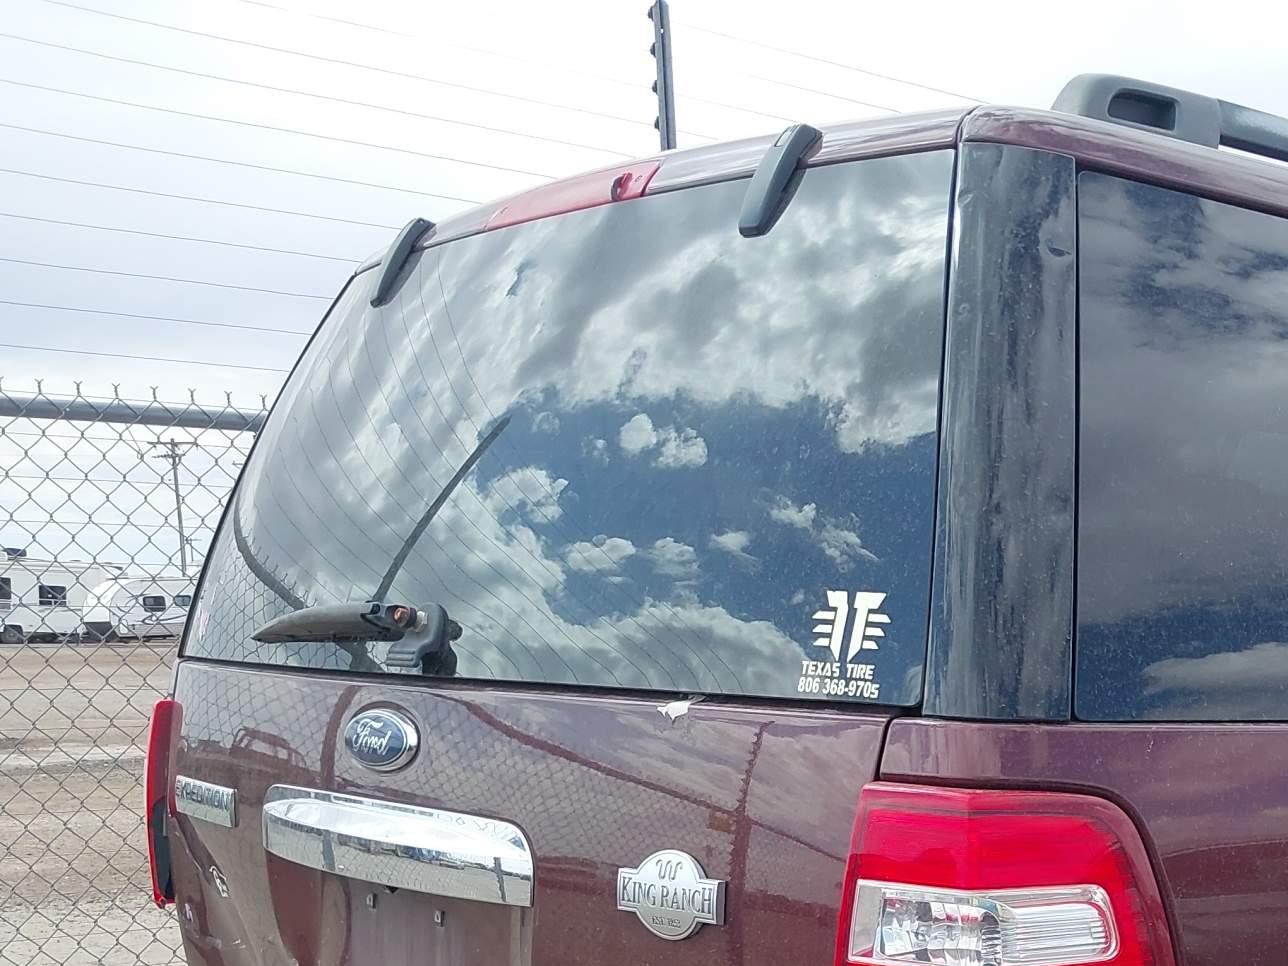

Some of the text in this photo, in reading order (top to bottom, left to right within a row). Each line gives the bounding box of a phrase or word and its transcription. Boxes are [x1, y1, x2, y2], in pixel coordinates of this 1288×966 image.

[802, 661, 875, 680] TEXAS TIRE
[797, 676, 880, 698] 806 368-9705
[352, 718, 392, 756] Ford
[621, 876, 713, 914] KING RANCH
